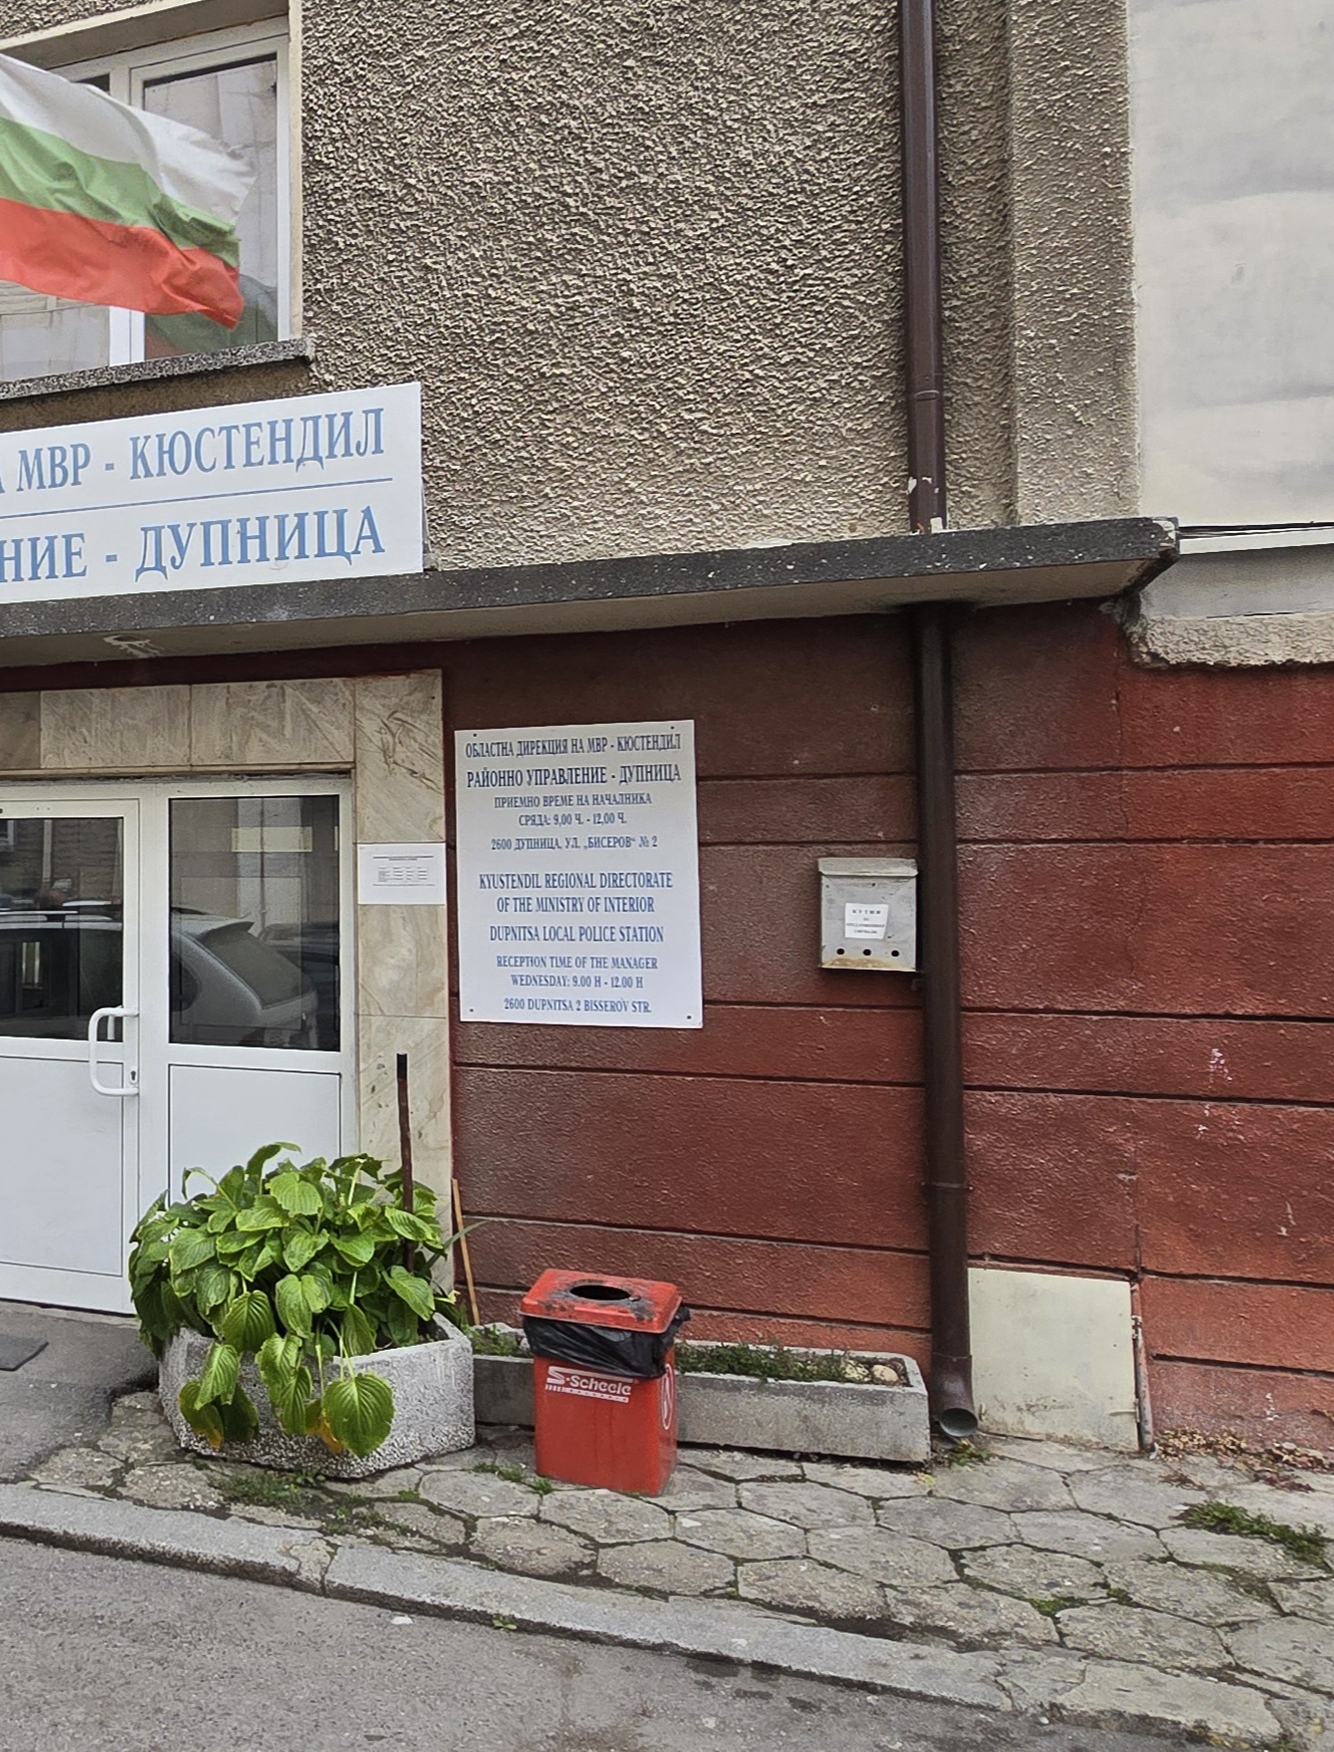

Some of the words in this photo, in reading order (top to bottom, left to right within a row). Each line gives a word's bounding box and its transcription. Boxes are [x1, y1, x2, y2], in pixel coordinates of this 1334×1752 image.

[16, 442, 91, 493] МВР
[129, 407, 385, 481] КЮСТЕНДИЛ
[134, 505, 386, 582] ДУПНИЦА
[466, 741, 514, 758] ОБЛАСТНА
[516, 738, 567, 758] ДИРЕКЦИЯ
[571, 738, 584, 754] НА
[587, 737, 608, 753] МВР
[617, 733, 681, 752] КЮСТЕНДИЛ
[467, 767, 523, 788] РАЙОННО
[527, 766, 607, 786] УПРАВЛЕНИЕ
[619, 764, 681, 785] ДУПНИЦА
[494, 796, 539, 808] ПРИЕМНО
[542, 795, 574, 808] ВРЕМЕ
[576, 794, 590, 806] НА
[592, 792, 652, 806] НАЧАЛНИКА
[518, 814, 551, 826] СРЯДА:
[491, 838, 512, 850] 2600
[652, 835, 658, 847] 2
[479, 873, 542, 889] KYUSTENDIL
[545, 872, 596, 888] REGIONAL
[599, 872, 673, 888] DIRECTORATE
[497, 897, 511, 912] OF
[513, 897, 532, 912] THE
[535, 897, 584, 912] MINISTRY
[587, 897, 600, 912] OF
[604, 896, 655, 912] INTERIOR
[490, 925, 540, 941] DUPNITSA
[543, 926, 576, 941] LOCAL
[579, 926, 616, 941] POLICE
[619, 926, 664, 942] STATION
[496, 955, 546, 967] RECEPTION
[549, 956, 572, 968] TIME
[575, 956, 587, 968] OF
[590, 956, 608, 969] THE
[611, 957, 658, 969] MANAGER
[510, 974, 570, 987] WEDNESDAY:
[594, 975, 602, 988] H
[636, 976, 643, 988] H
[504, 997, 525, 1010] 2600
[527, 998, 574, 1011] DUPNITSA
[576, 999, 581, 1011] 2
[584, 999, 629, 1013] BISSEROV
[631, 1001, 652, 1013] STR.
